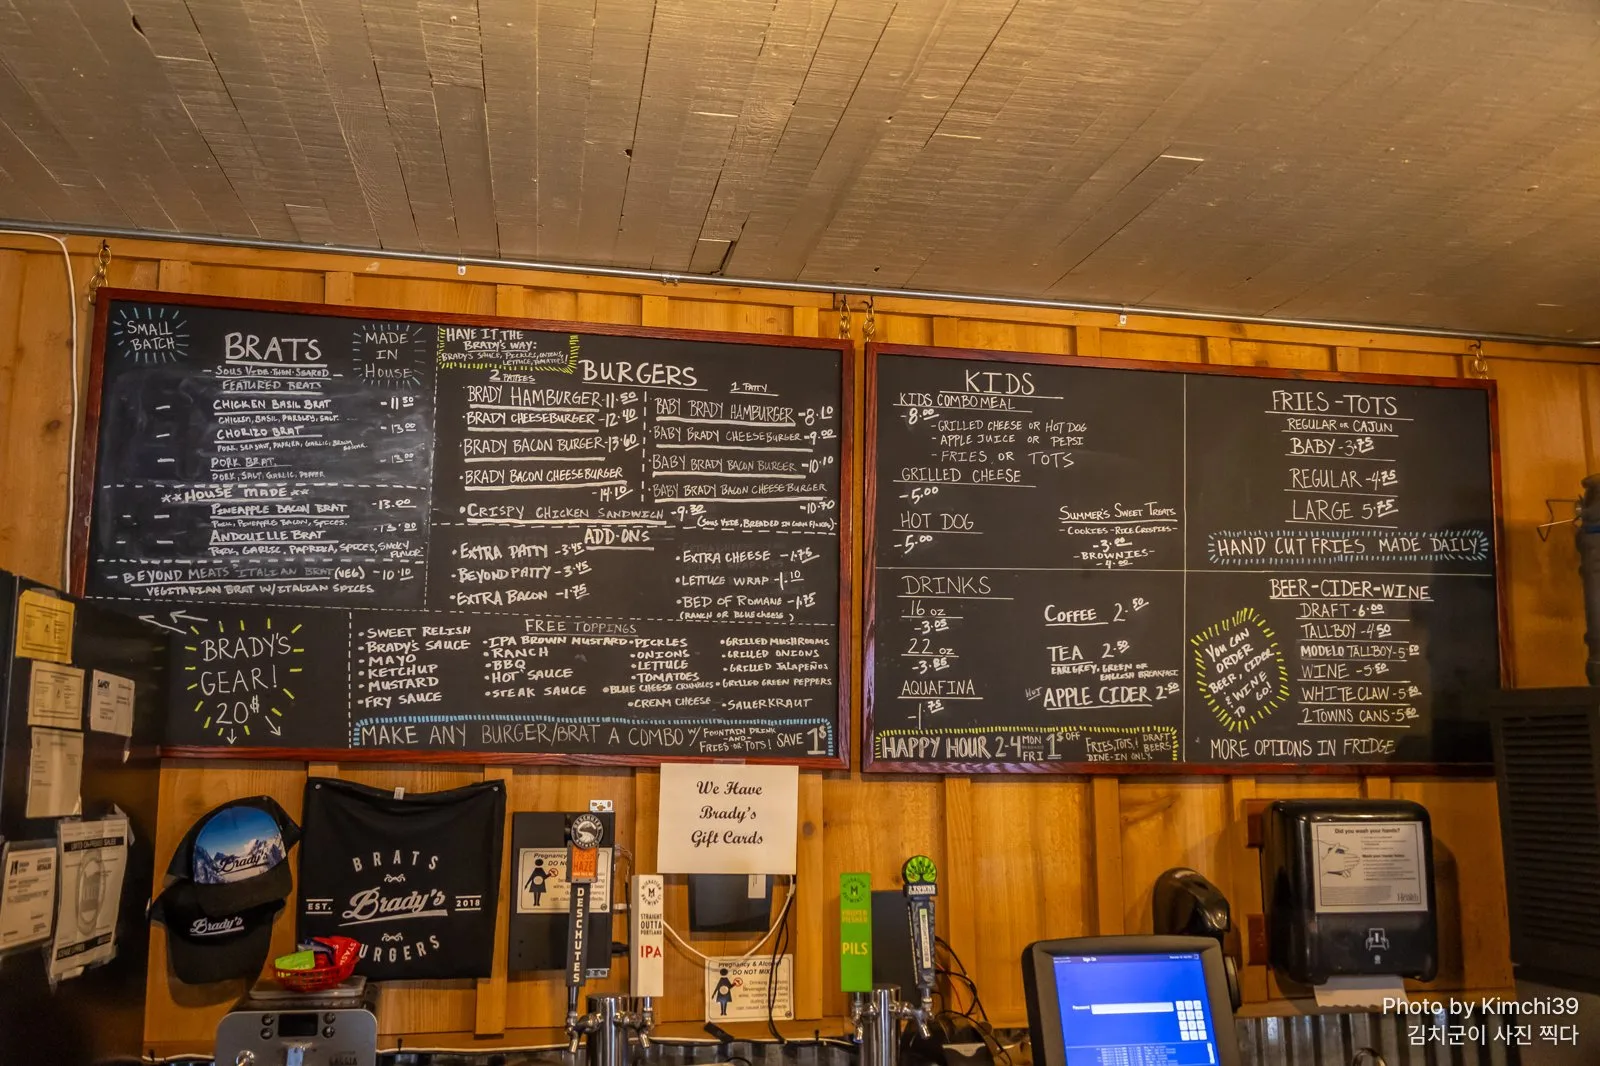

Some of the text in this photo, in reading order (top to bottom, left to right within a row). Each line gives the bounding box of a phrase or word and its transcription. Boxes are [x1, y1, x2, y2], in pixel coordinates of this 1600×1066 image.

[127, 320, 173, 337] SMALL
[131, 337, 175, 351] BATCH
[366, 332, 409, 344] MADE
[225, 332, 322, 362] BRATS
[376, 349, 398, 360] IN
[365, 363, 412, 379] HOUSE
[578, 359, 698, 387] BURGERS
[966, 369, 1035, 395] KIDS
[467, 386, 602, 407] BRADY HAMBURGER
[900, 393, 1016, 410] KIDS COMBO MEAL
[1272, 390, 1398, 416] FRIES TOTS
[213, 400, 332, 410] CHICKEN BASIL BRAT
[655, 398, 796, 424] BABY BRADY HAMBURGER
[467, 411, 595, 426] BRADY CHEESEBURGER
[217, 425, 305, 440] CHORIZO BRAT
[653, 426, 803, 443] BABY BRADY CHEESEBURGER
[464, 437, 605, 456] BRADY BACON BURGER
[940, 435, 1085, 449] APPLE JUICE OR PEPSI
[1290, 437, 1336, 455] BABY
[941, 450, 1075, 469] FRIES OR TOTS
[465, 467, 623, 486] BRADY BACON CHEESEBURGER
[901, 467, 1022, 483] GRILLED CHEESE
[1289, 468, 1363, 490] REGULAR
[211, 504, 348, 515] PINEAPPLE BACON BRAT
[1293, 499, 1354, 521] LARGE
[900, 511, 974, 531] HOT DOG
[210, 530, 327, 543] ANDOUILLE BRAT
[460, 543, 548, 560] EXTRA PATTY
[1080, 549, 1149, 560] BROWNIES
[1218, 537, 1478, 556] HAND CUT FRIES MADE DAILY
[683, 550, 771, 563] EXTRA CHEESE
[457, 565, 551, 583] BEYOND PATTY
[681, 575, 769, 586] LETTUCE WRAP
[900, 575, 992, 595] DRINKS
[457, 590, 548, 606] EXTRA BACON
[1044, 605, 1097, 622] COFFEE
[1299, 602, 1350, 618] DRAFT
[367, 626, 471, 639] SWEET RELISH
[525, 618, 637, 634] FREE TOPPINGS
[1300, 622, 1356, 640] TALLBOY
[201, 633, 291, 662] BRADY'S
[366, 640, 471, 654] BRADY'S SAUCE
[635, 638, 688, 648] PICKLES
[369, 654, 416, 667] MAYO
[492, 647, 549, 660] RANCH
[637, 650, 690, 659] ONIONS
[1047, 645, 1084, 662] TEA
[1216, 643, 1254, 673] ORDER
[368, 663, 438, 679] KETCHUP
[638, 660, 688, 671] LETTUCE
[1301, 664, 1350, 679] WINE
[202, 664, 277, 696] GEAR!
[492, 668, 574, 683] HOT SAUCE
[637, 672, 700, 683] TOMATOES
[368, 677, 439, 692] MUSTARD
[492, 686, 587, 698] STEAK SAUCE
[902, 680, 976, 696] AQUAFINA
[1301, 685, 1390, 702] WHITE CLAW
[728, 698, 812, 710] SAUERKRAUT
[361, 722, 684, 747] MAKE ANY BURGER/BRAT A COMBO
[777, 735, 804, 750] SAVE
[1022, 734, 1042, 745] MON
[882, 736, 1021, 760] HAPPY HOUR 2-4
[1023, 750, 1043, 762] FRI
[1210, 737, 1396, 760] MORE OPTIONS IN FRIDGE
[696, 780, 763, 795] We Have
[699, 805, 757, 824] Brady's
[691, 830, 763, 848] Gift Cards
[352, 849, 439, 872] BRATS
[307, 902, 332, 911] EST.
[342, 886, 447, 920] Brady's
[456, 900, 481, 908] 2018
[190, 916, 244, 934] Brady's
[641, 921, 663, 930] OUTTA
[573, 888, 585, 983] DESCHUTES
[358, 935, 441, 962] URGERS
[641, 945, 663, 958] IPA
[842, 942, 868, 955] PILS
